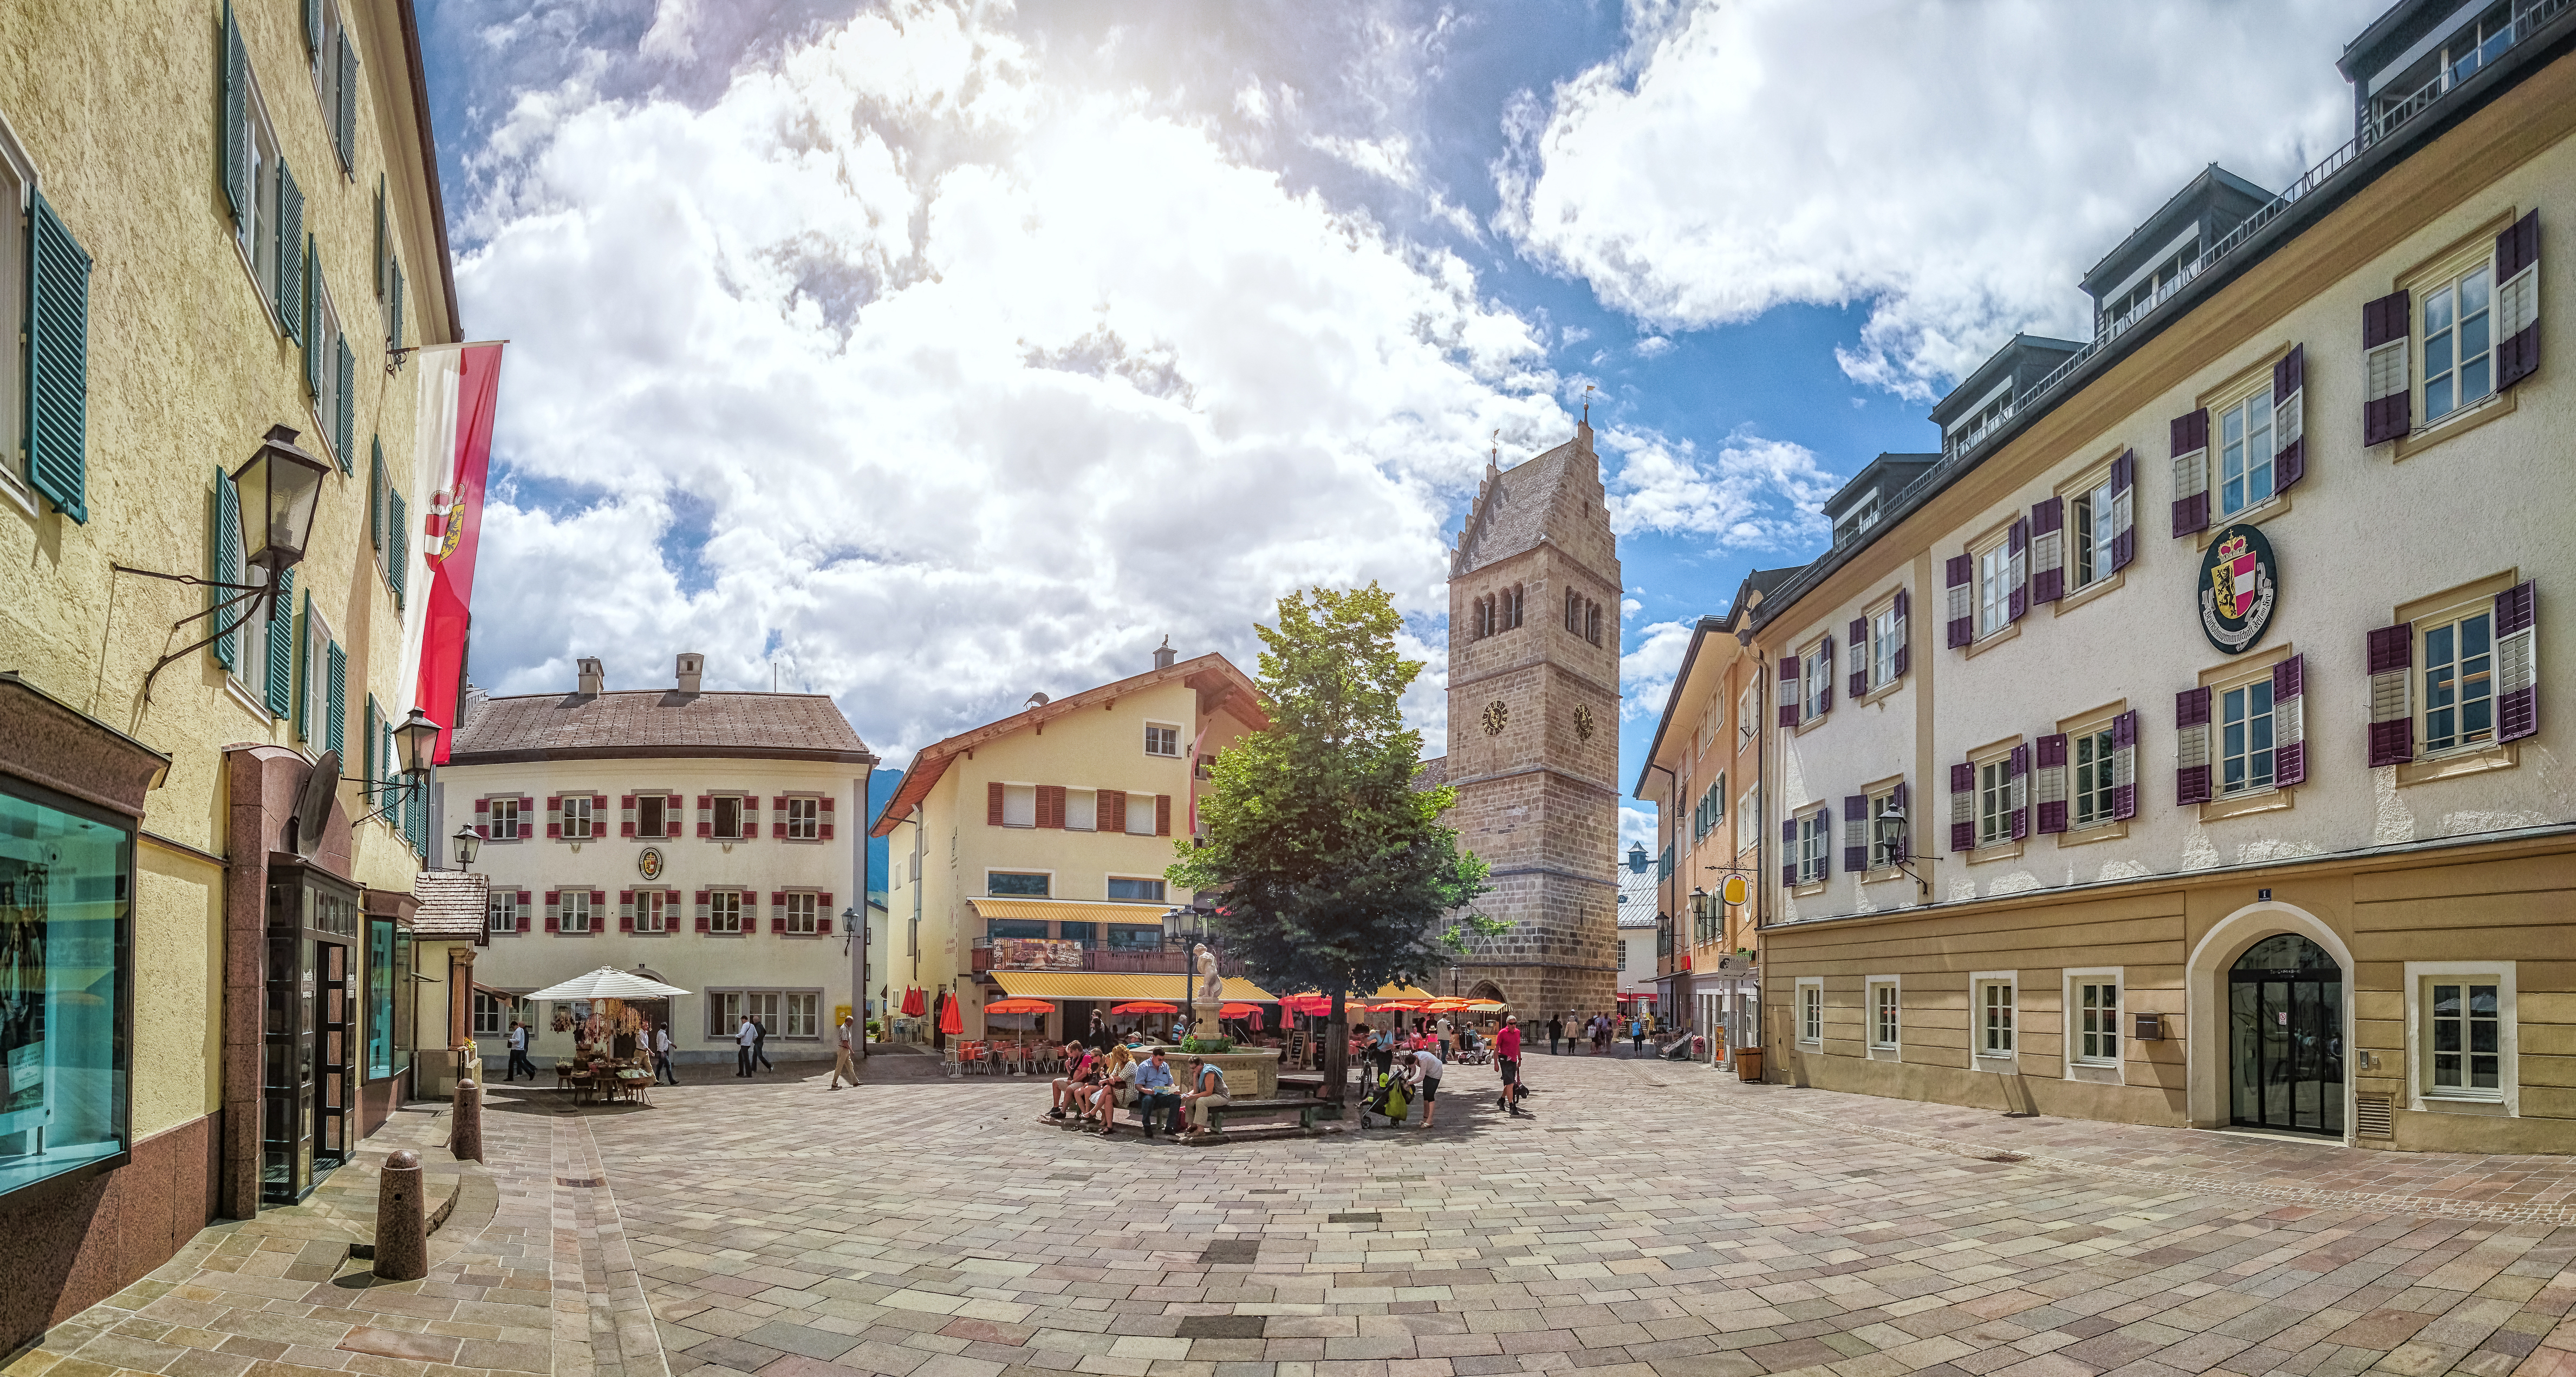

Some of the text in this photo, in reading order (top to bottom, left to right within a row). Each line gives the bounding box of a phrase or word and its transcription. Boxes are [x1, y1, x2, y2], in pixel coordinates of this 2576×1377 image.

[2262, 593, 2272, 609] See
[2260, 608, 2266, 617] am
[2252, 615, 2263, 630] Zell
